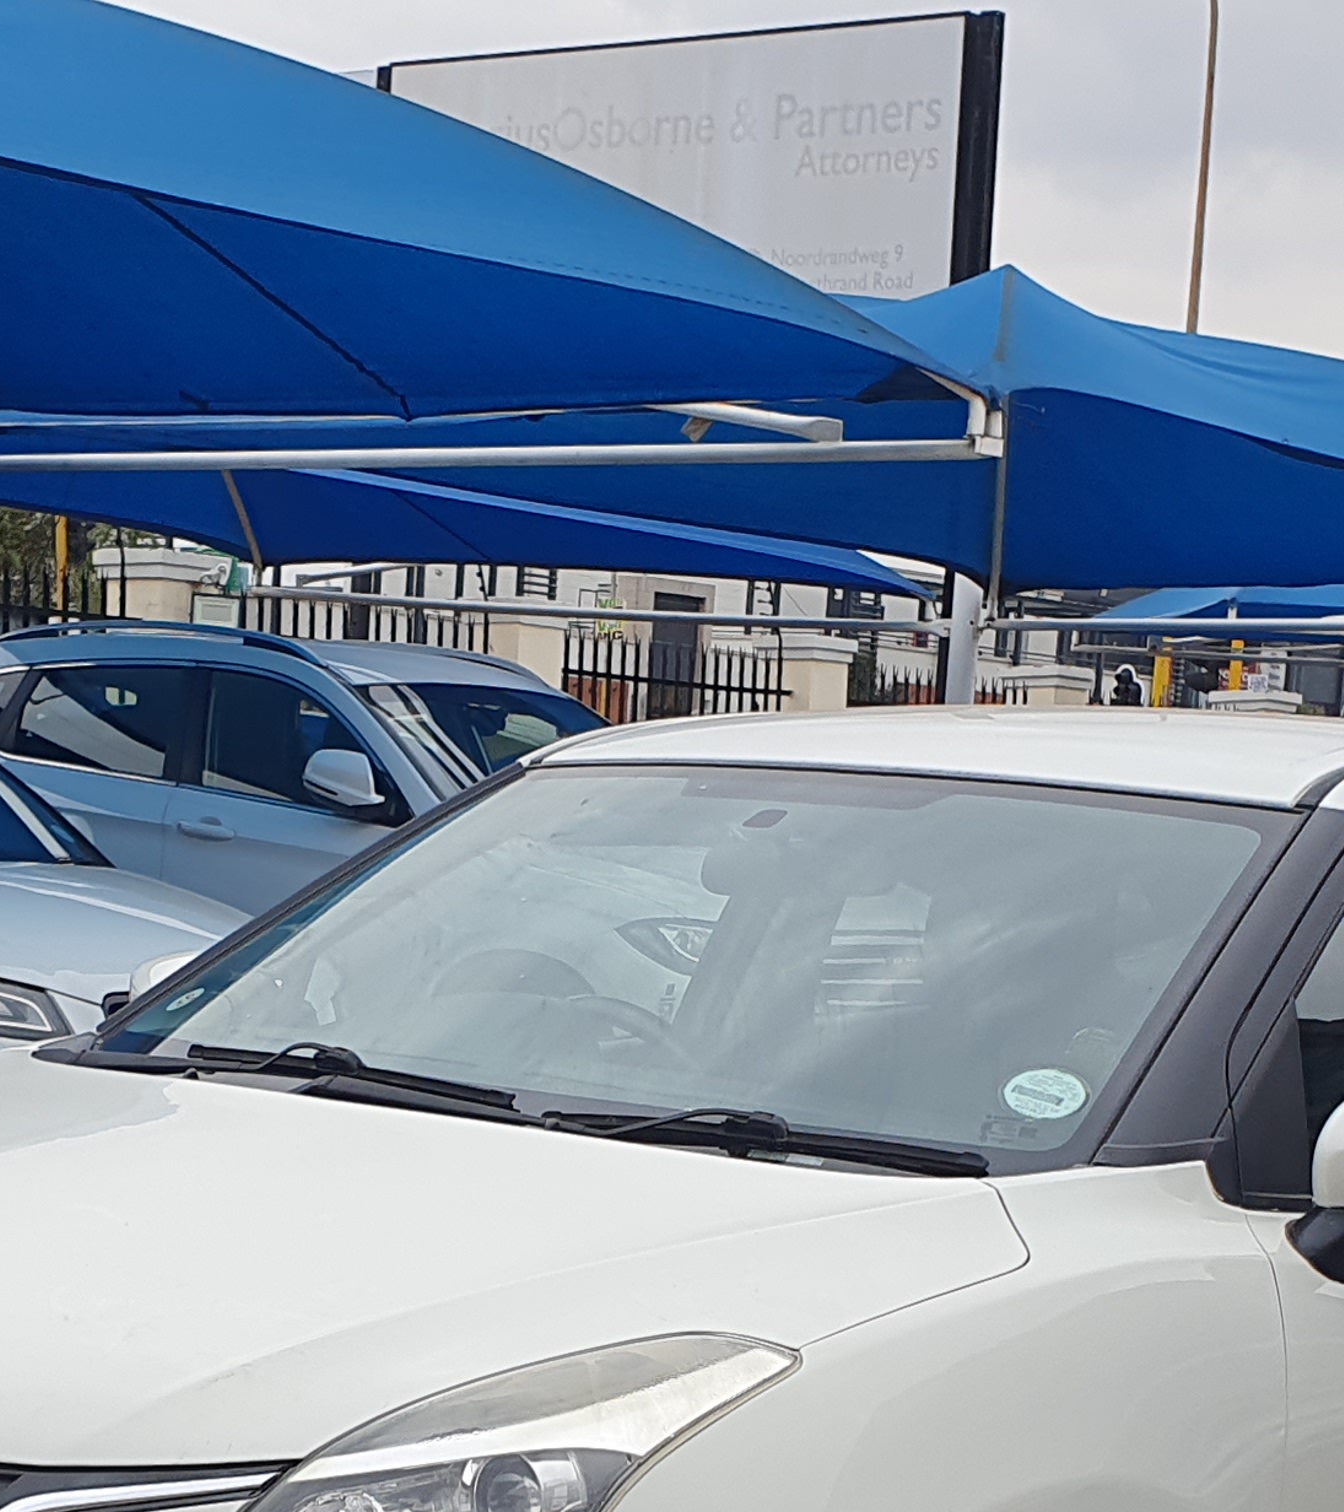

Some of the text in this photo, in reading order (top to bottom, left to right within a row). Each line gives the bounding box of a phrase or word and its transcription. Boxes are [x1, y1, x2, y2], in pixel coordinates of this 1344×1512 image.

[494, 93, 944, 152] iusOsborne & Partners
[794, 144, 939, 183] Attorneys
[894, 243, 905, 263] 9
[872, 270, 914, 290] Road
